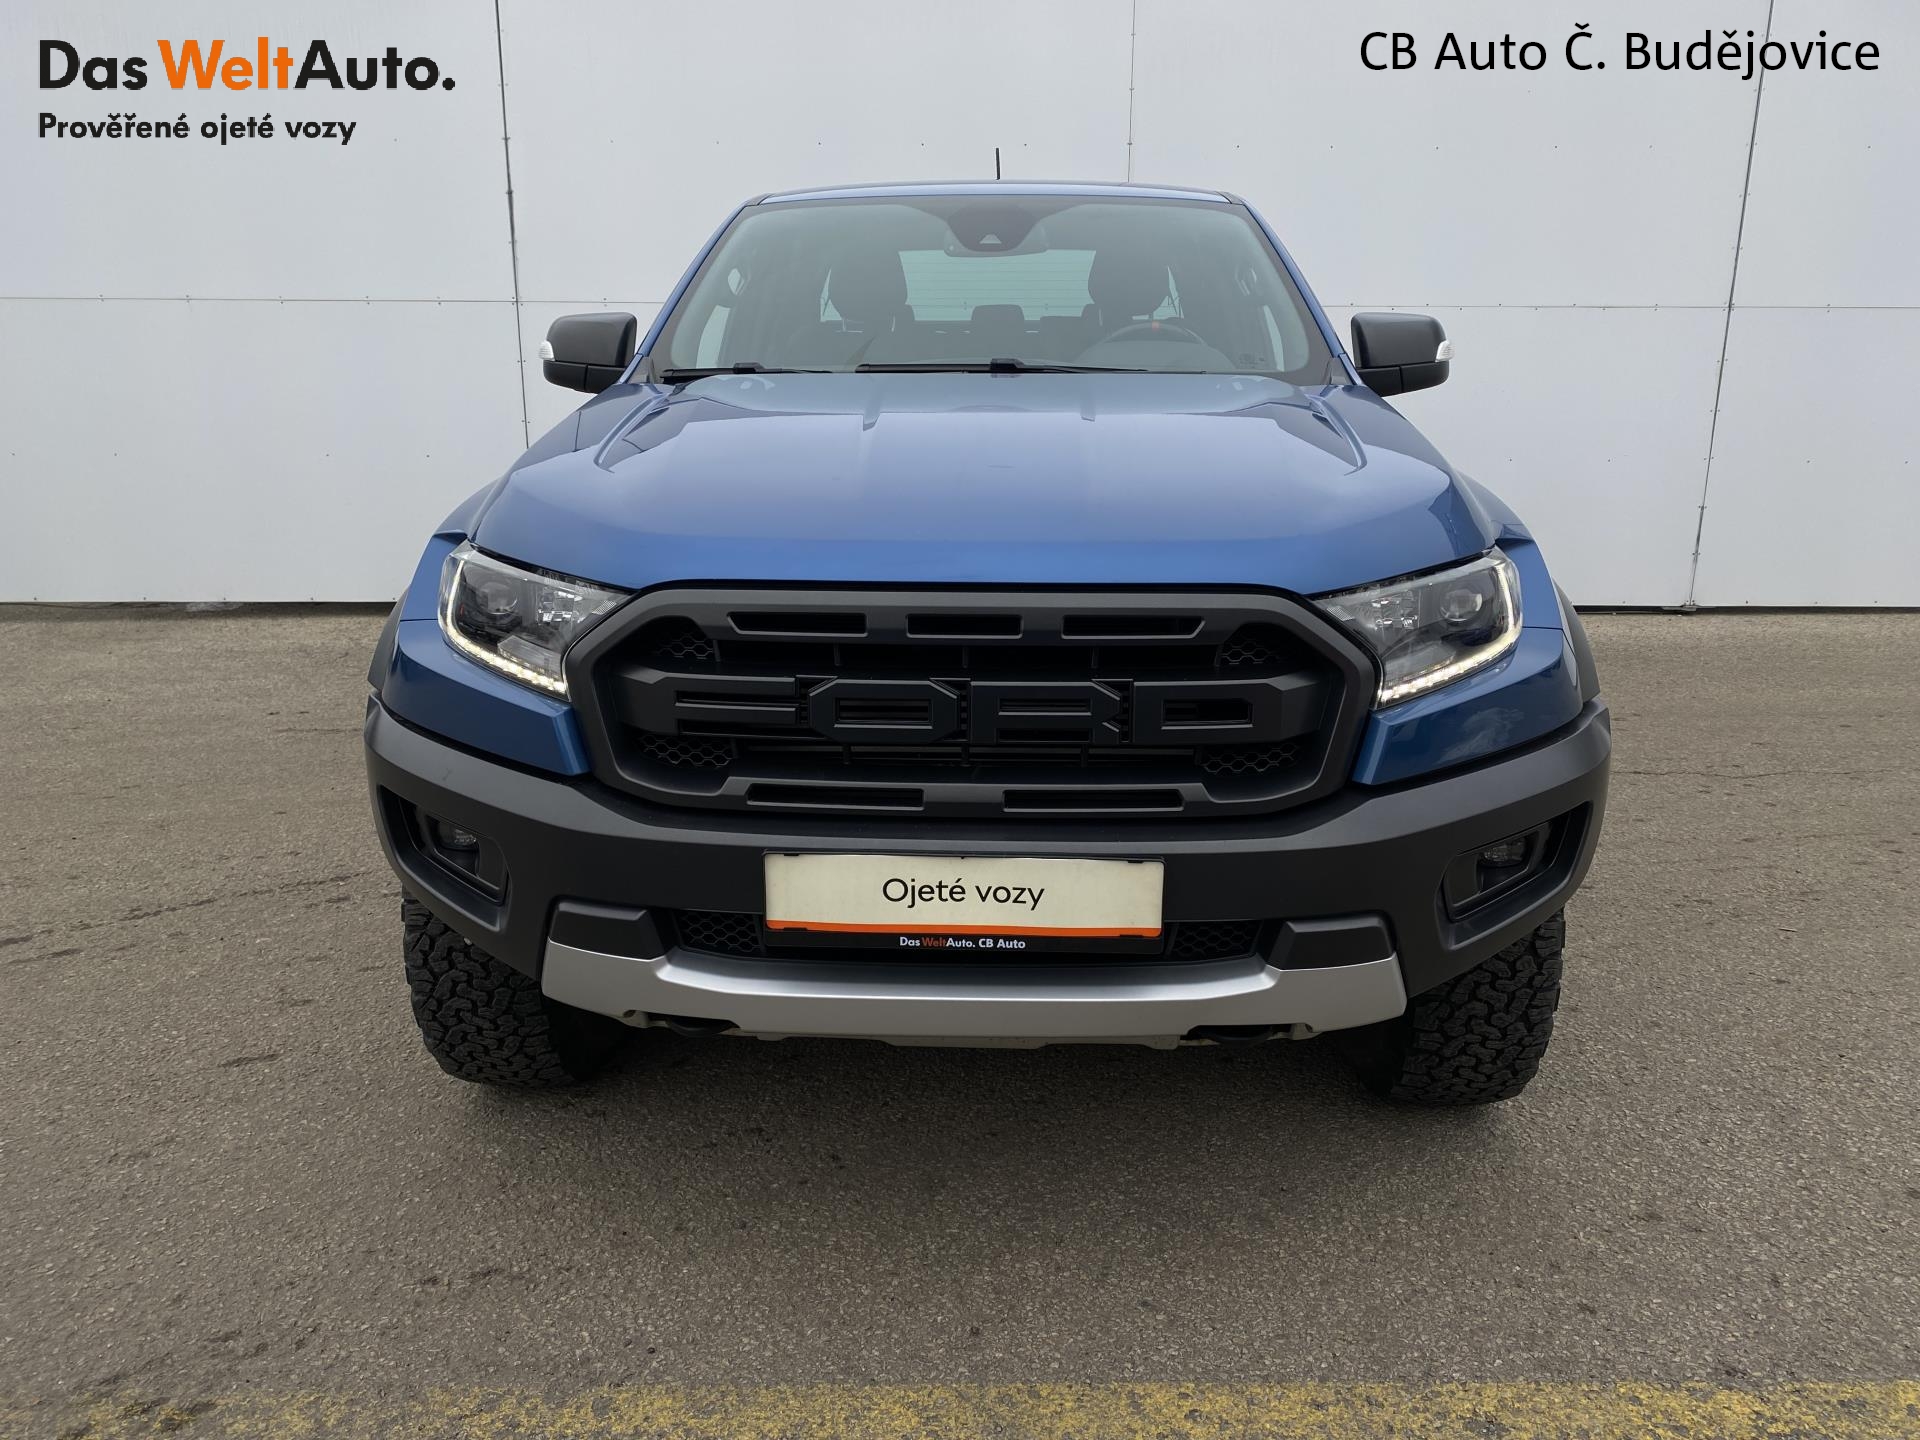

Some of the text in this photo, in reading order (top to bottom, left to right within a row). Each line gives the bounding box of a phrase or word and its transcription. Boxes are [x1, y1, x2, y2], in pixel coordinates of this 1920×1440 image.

[617, 669, 1320, 744] FORD
[882, 877, 1046, 912] Ojeté vozy
[899, 936, 921, 947] Das
[978, 938, 994, 948] CB
[996, 938, 1026, 949] Auto
